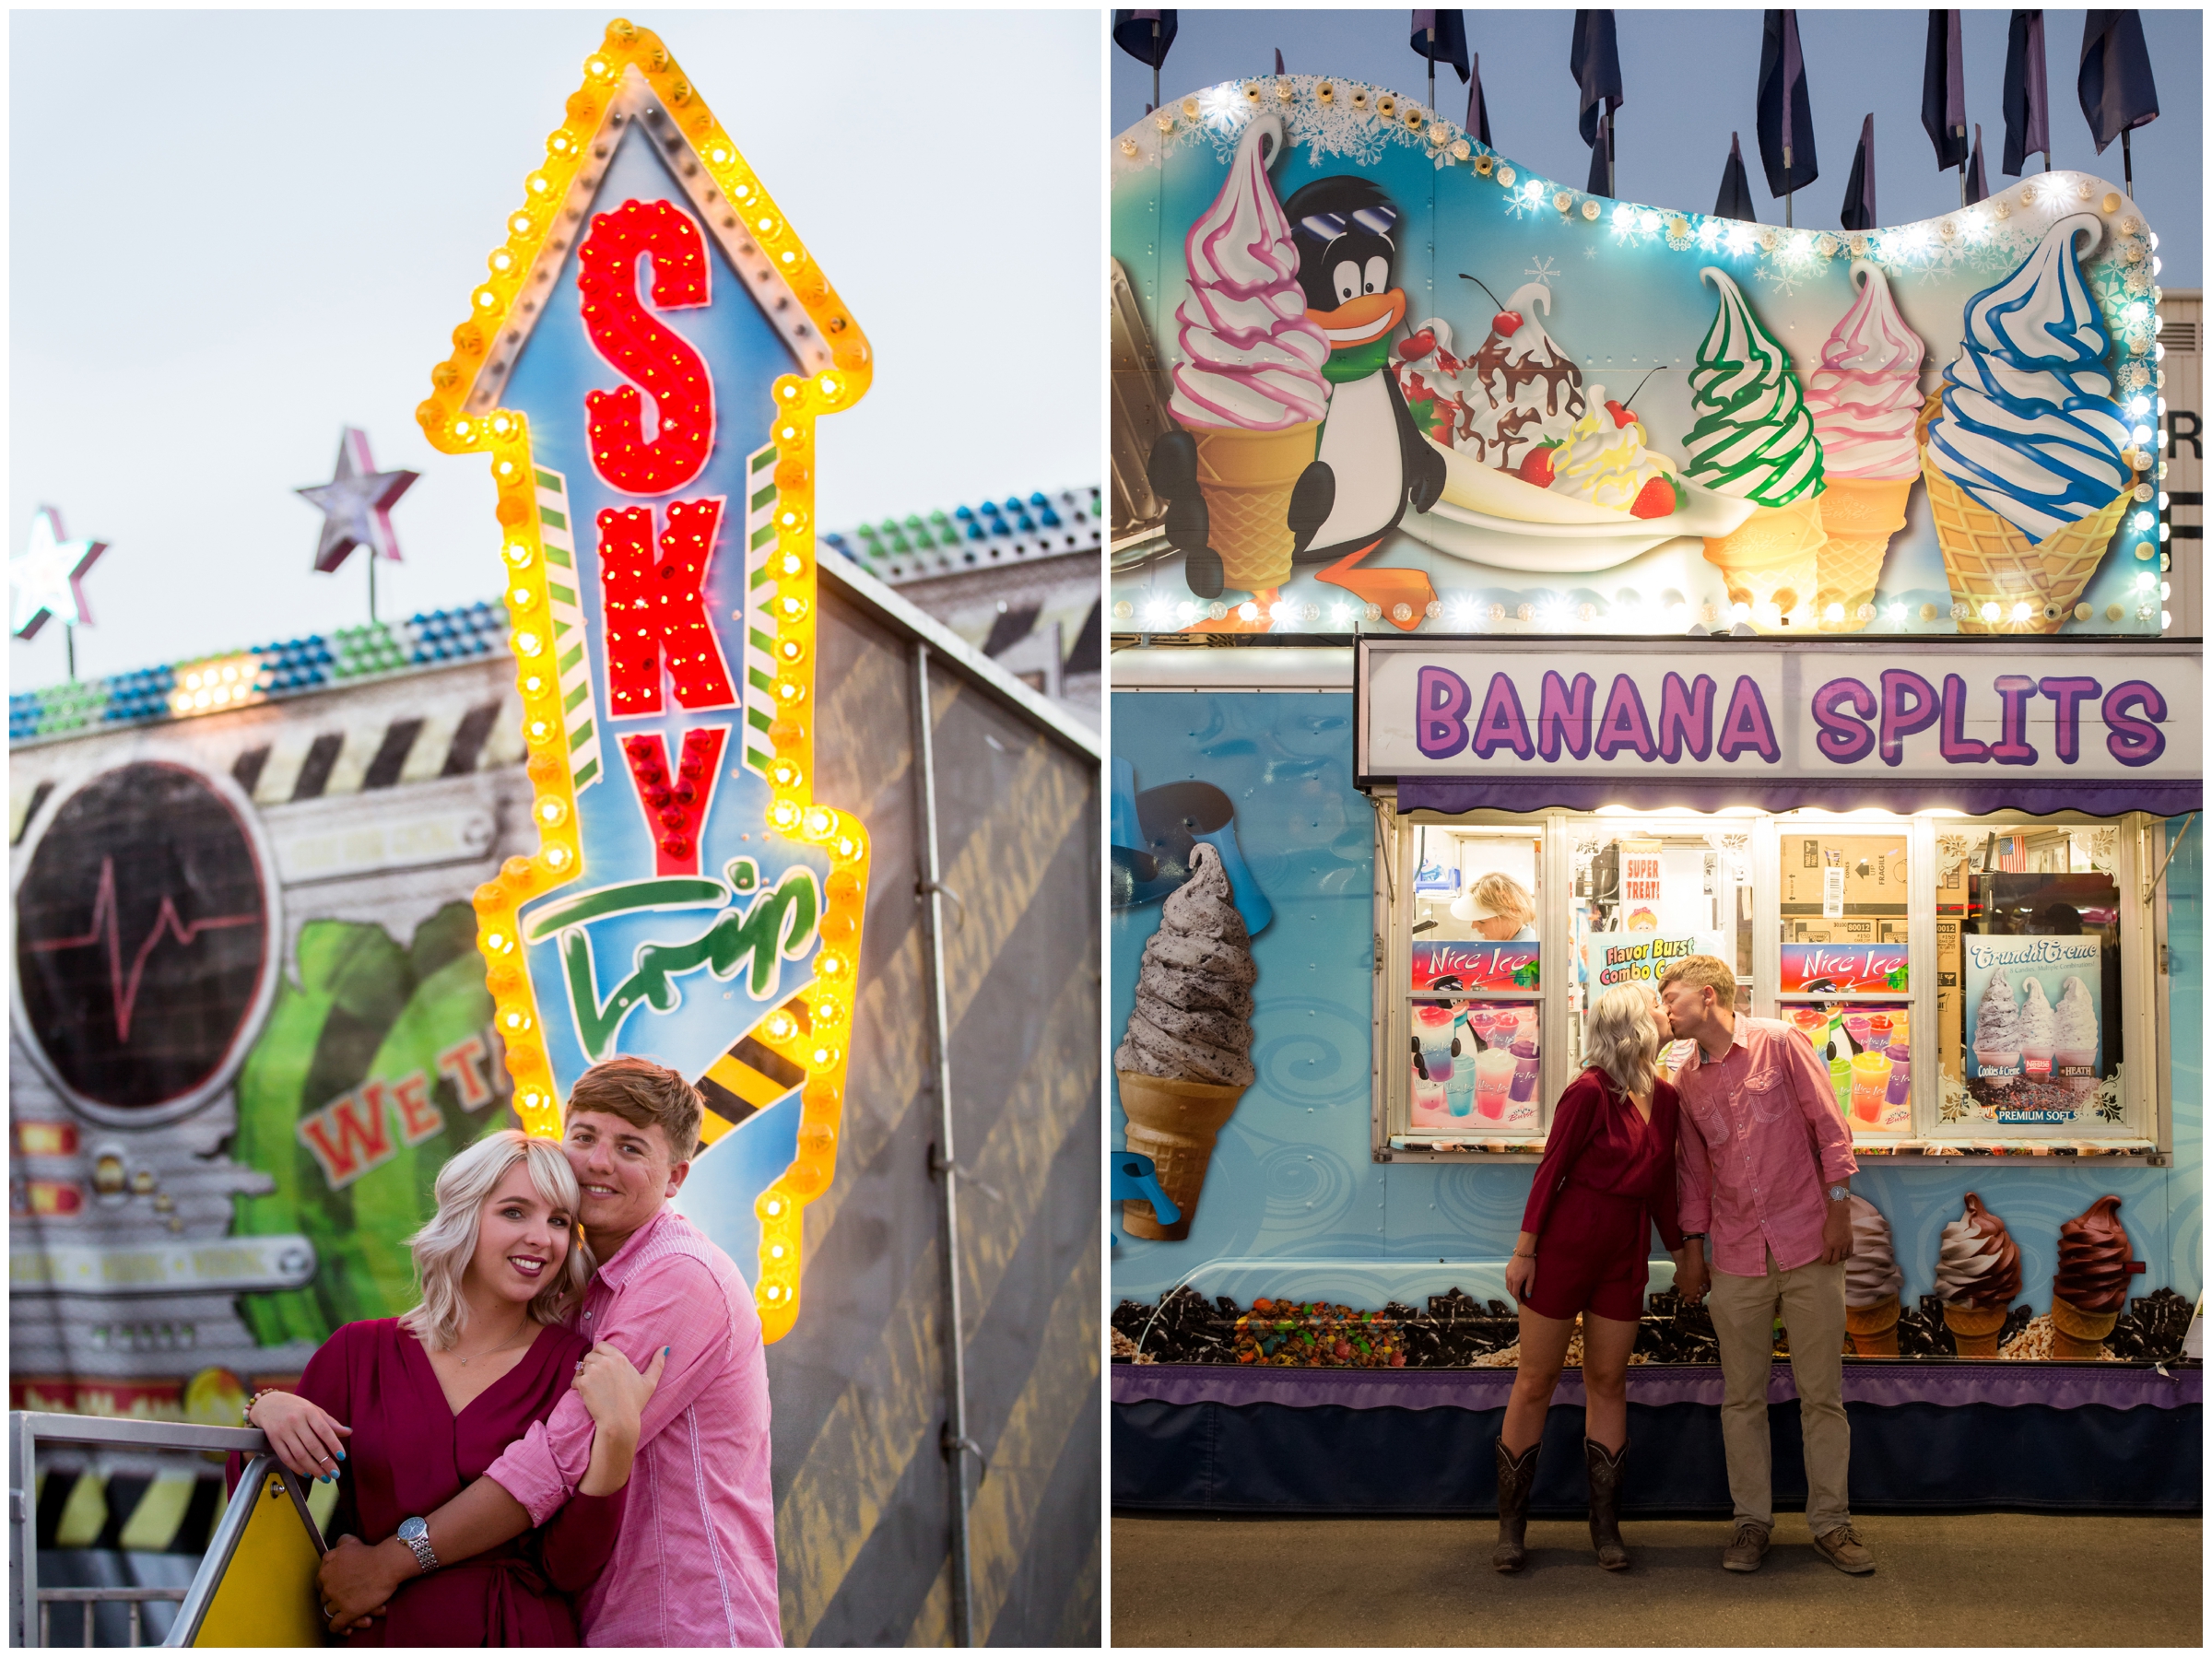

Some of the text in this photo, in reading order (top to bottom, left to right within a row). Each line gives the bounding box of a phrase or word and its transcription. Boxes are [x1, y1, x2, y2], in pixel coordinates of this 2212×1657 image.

[579, 195, 741, 877] SKY
[1417, 665, 2168, 768] BANANA SPLITS
[1628, 860, 1659, 879] SUPER
[1870, 864, 1876, 876] UP
[1626, 881, 1660, 901] TREAT!
[1848, 923, 1871, 932] 80012
[522, 856, 822, 1066] Trip
[1428, 946, 1528, 976] Nice Ice
[1606, 936, 1695, 967] Flavor Burst
[1802, 948, 1901, 979] Nice Ice
[1600, 962, 1651, 986] Combo
[1978, 1064, 2020, 1077] Cookies & Creme
[2065, 1066, 2091, 1076] HEATH
[1998, 1111, 2044, 1121] PREMIUM
[2046, 1111, 2071, 1121] SOFT
[295, 1069, 446, 1192] WE
